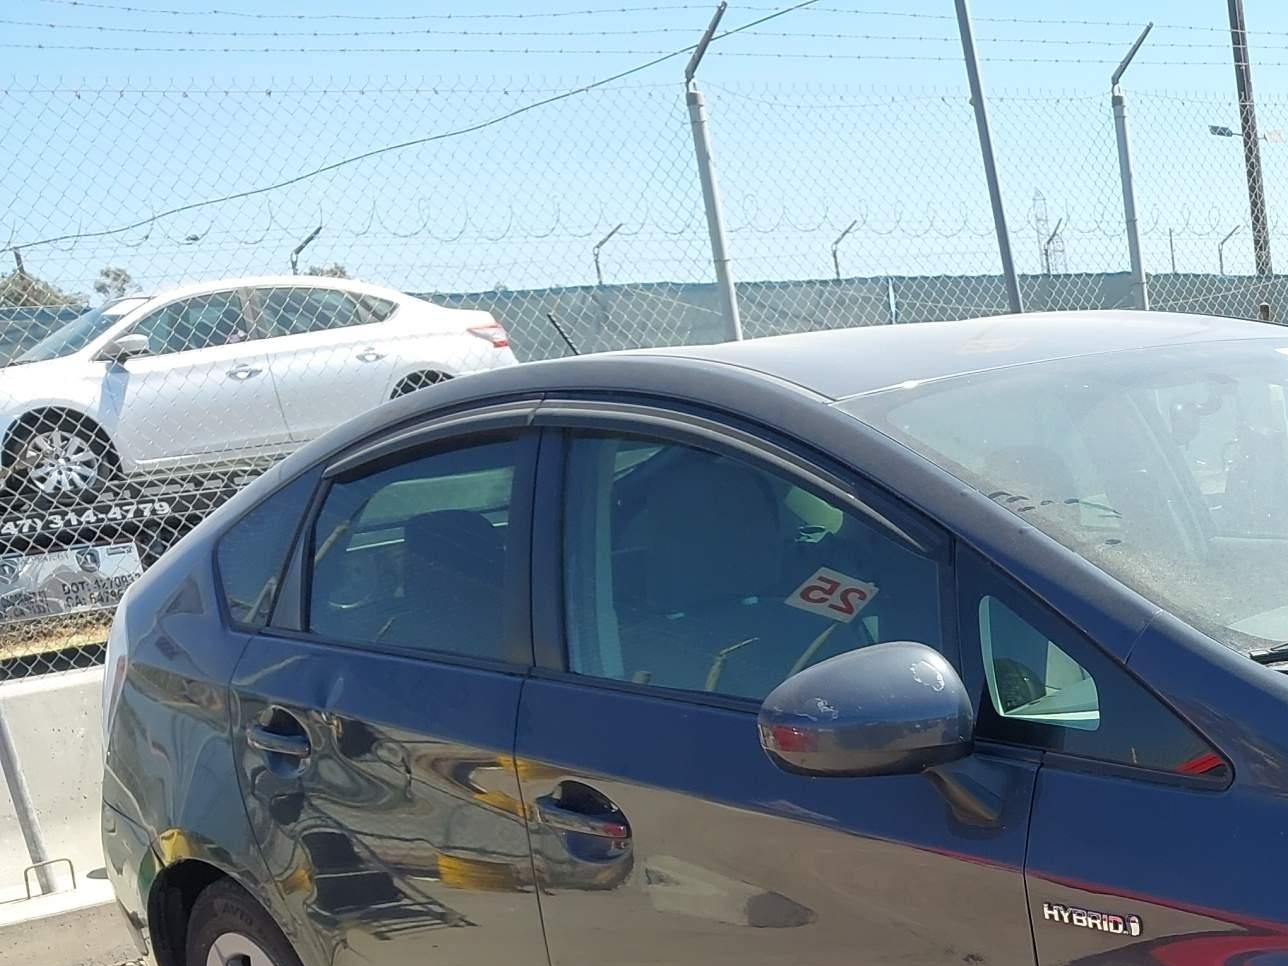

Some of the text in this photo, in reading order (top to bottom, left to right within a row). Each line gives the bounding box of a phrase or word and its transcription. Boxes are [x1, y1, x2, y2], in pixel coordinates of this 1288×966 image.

[49, 501, 170, 528] 314-4779
[62, 580, 90, 595] DOT:
[1043, 903, 1124, 934] HYBRID
